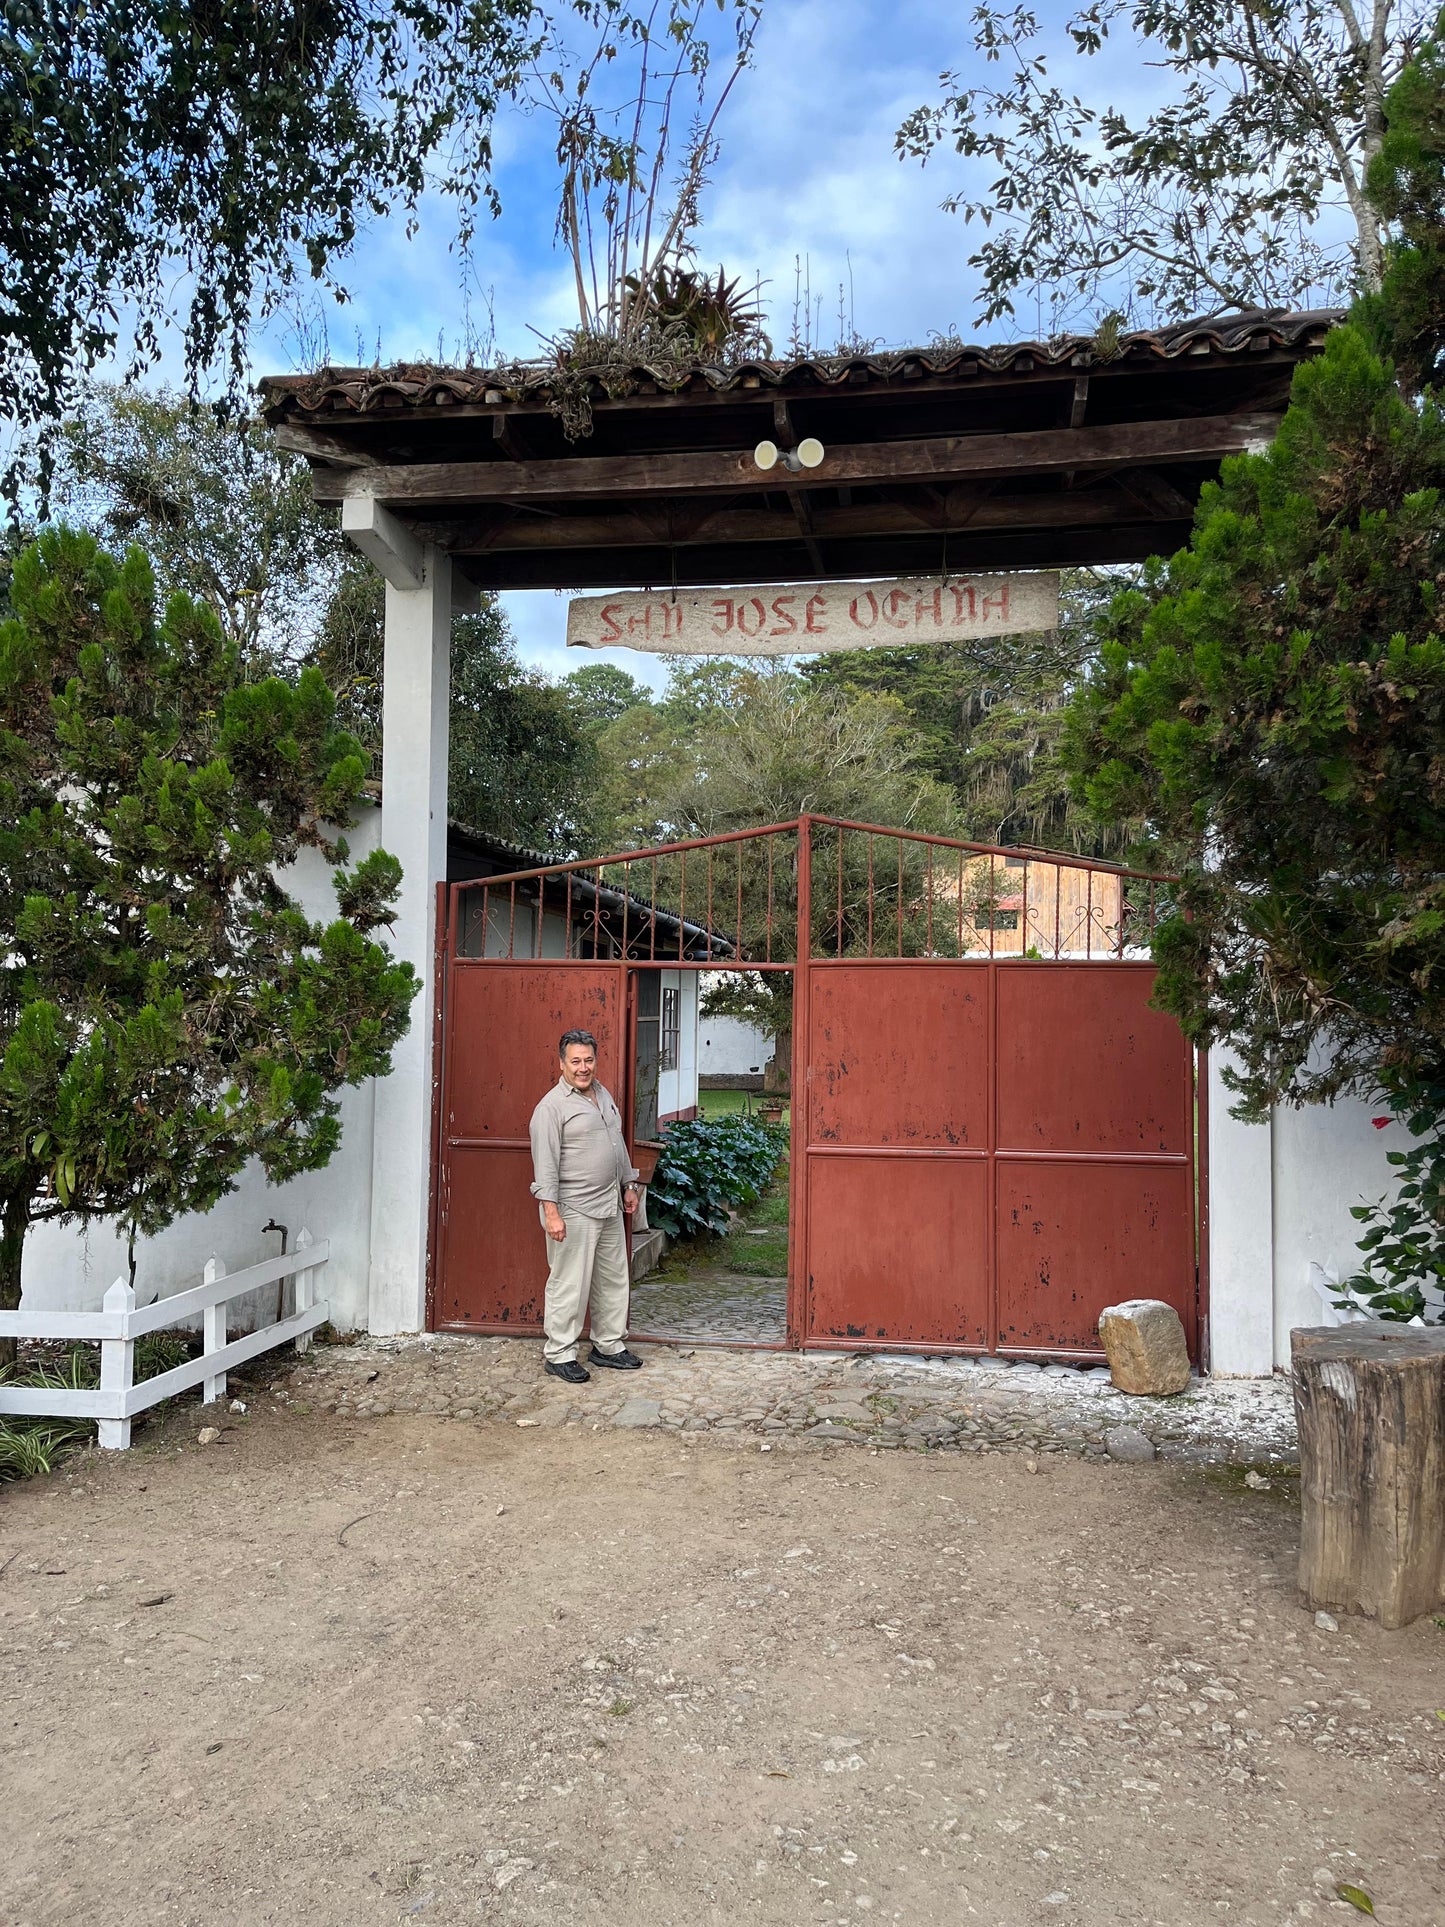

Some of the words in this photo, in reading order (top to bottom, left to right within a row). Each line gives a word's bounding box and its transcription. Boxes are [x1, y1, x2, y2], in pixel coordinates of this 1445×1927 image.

[600, 601, 684, 642] SAN
[711, 585, 828, 637] JOSÉ
[849, 578, 1010, 631] OCAÑA
